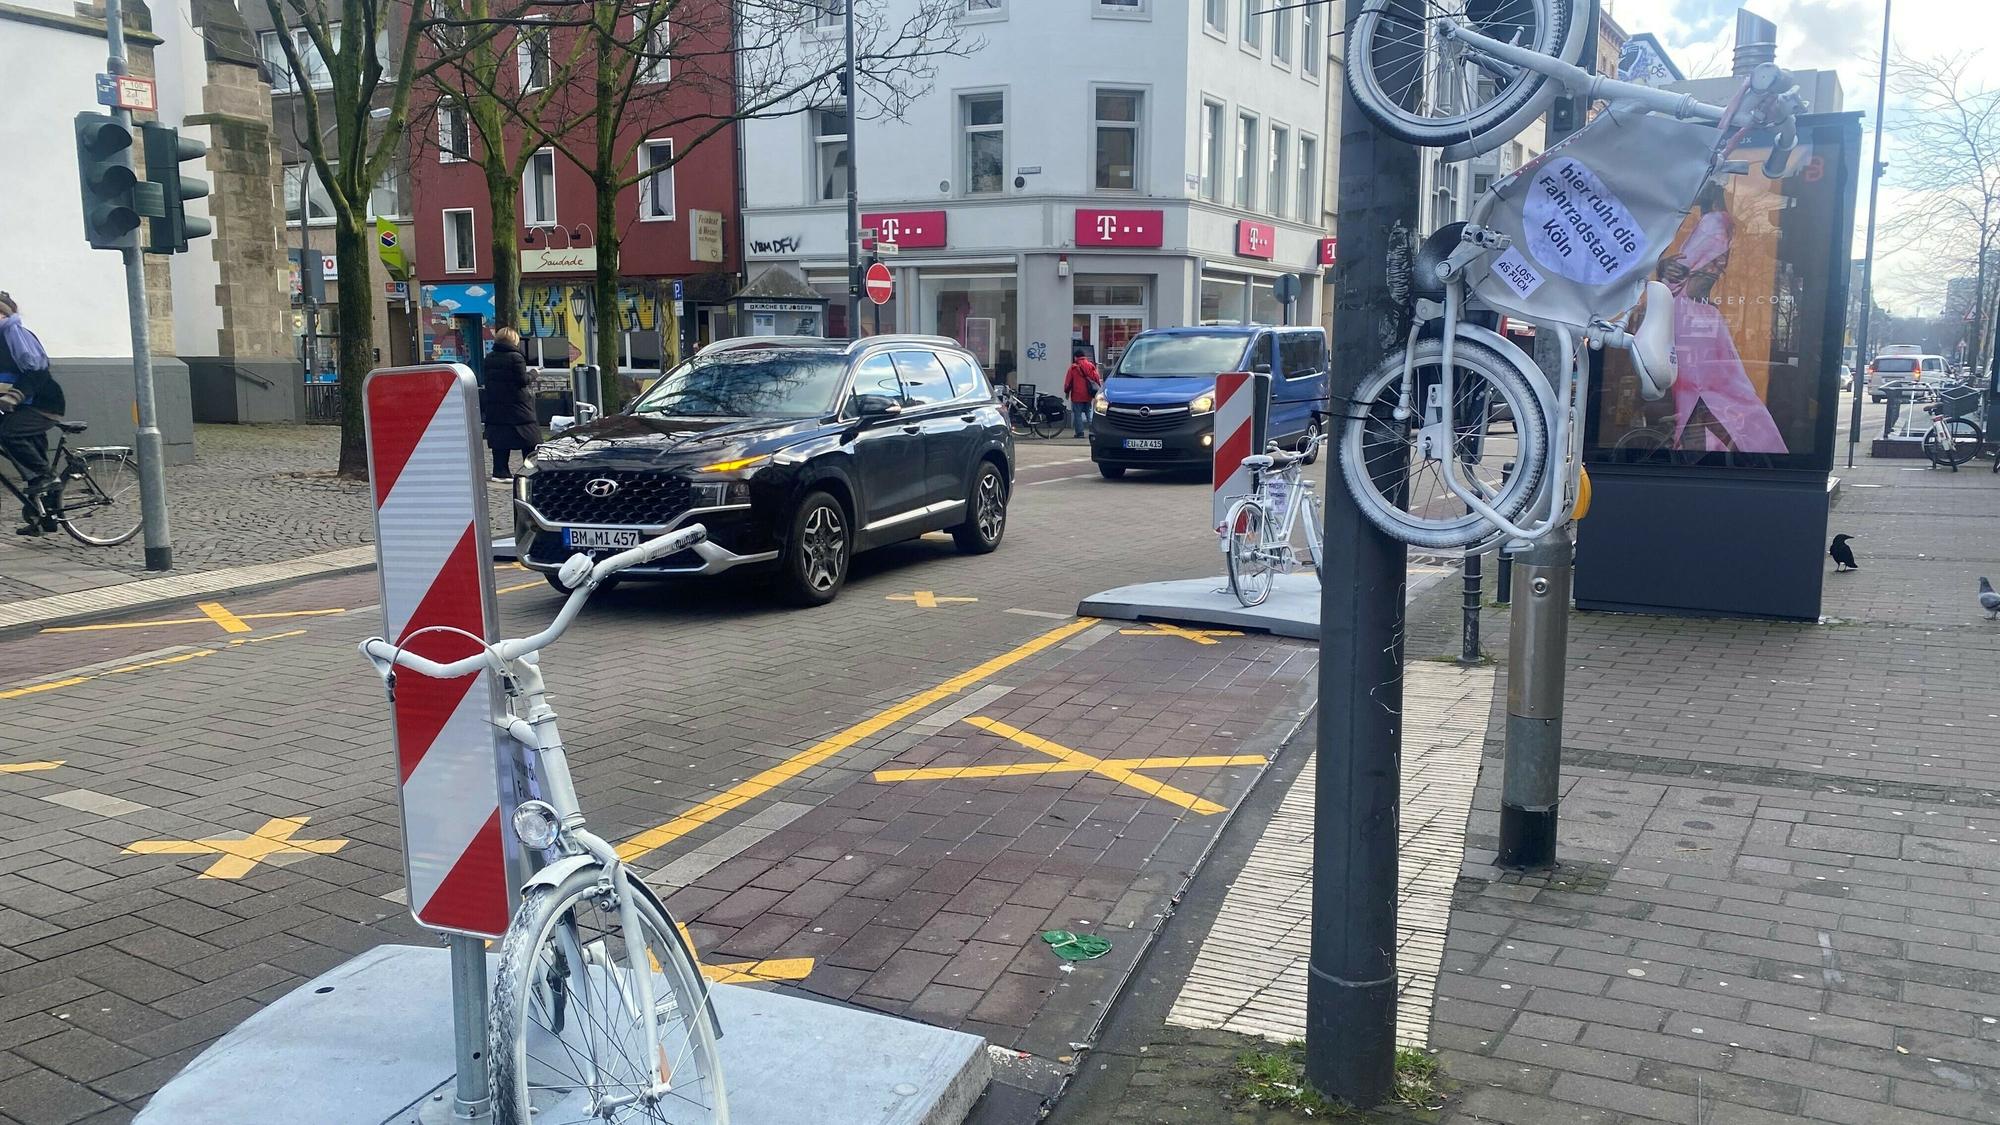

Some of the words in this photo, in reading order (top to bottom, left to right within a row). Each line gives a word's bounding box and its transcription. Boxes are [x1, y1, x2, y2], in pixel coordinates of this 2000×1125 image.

[1560, 163, 1592, 194] hier
[1588, 194, 1619, 228] ruht
[1613, 227, 1636, 254] die
[1539, 175, 1619, 274] Fahrradstadt
[1542, 219, 1574, 258] Köln
[536, 251, 584, 270] Saudade
[1498, 261, 1511, 275] AS
[1515, 264, 1536, 284] LOST
[1139, 439, 1149, 448] ZA
[1149, 440, 1162, 448] 415
[571, 530, 588, 545] BM
[594, 531, 610, 545] MI
[613, 532, 637, 546] 457
